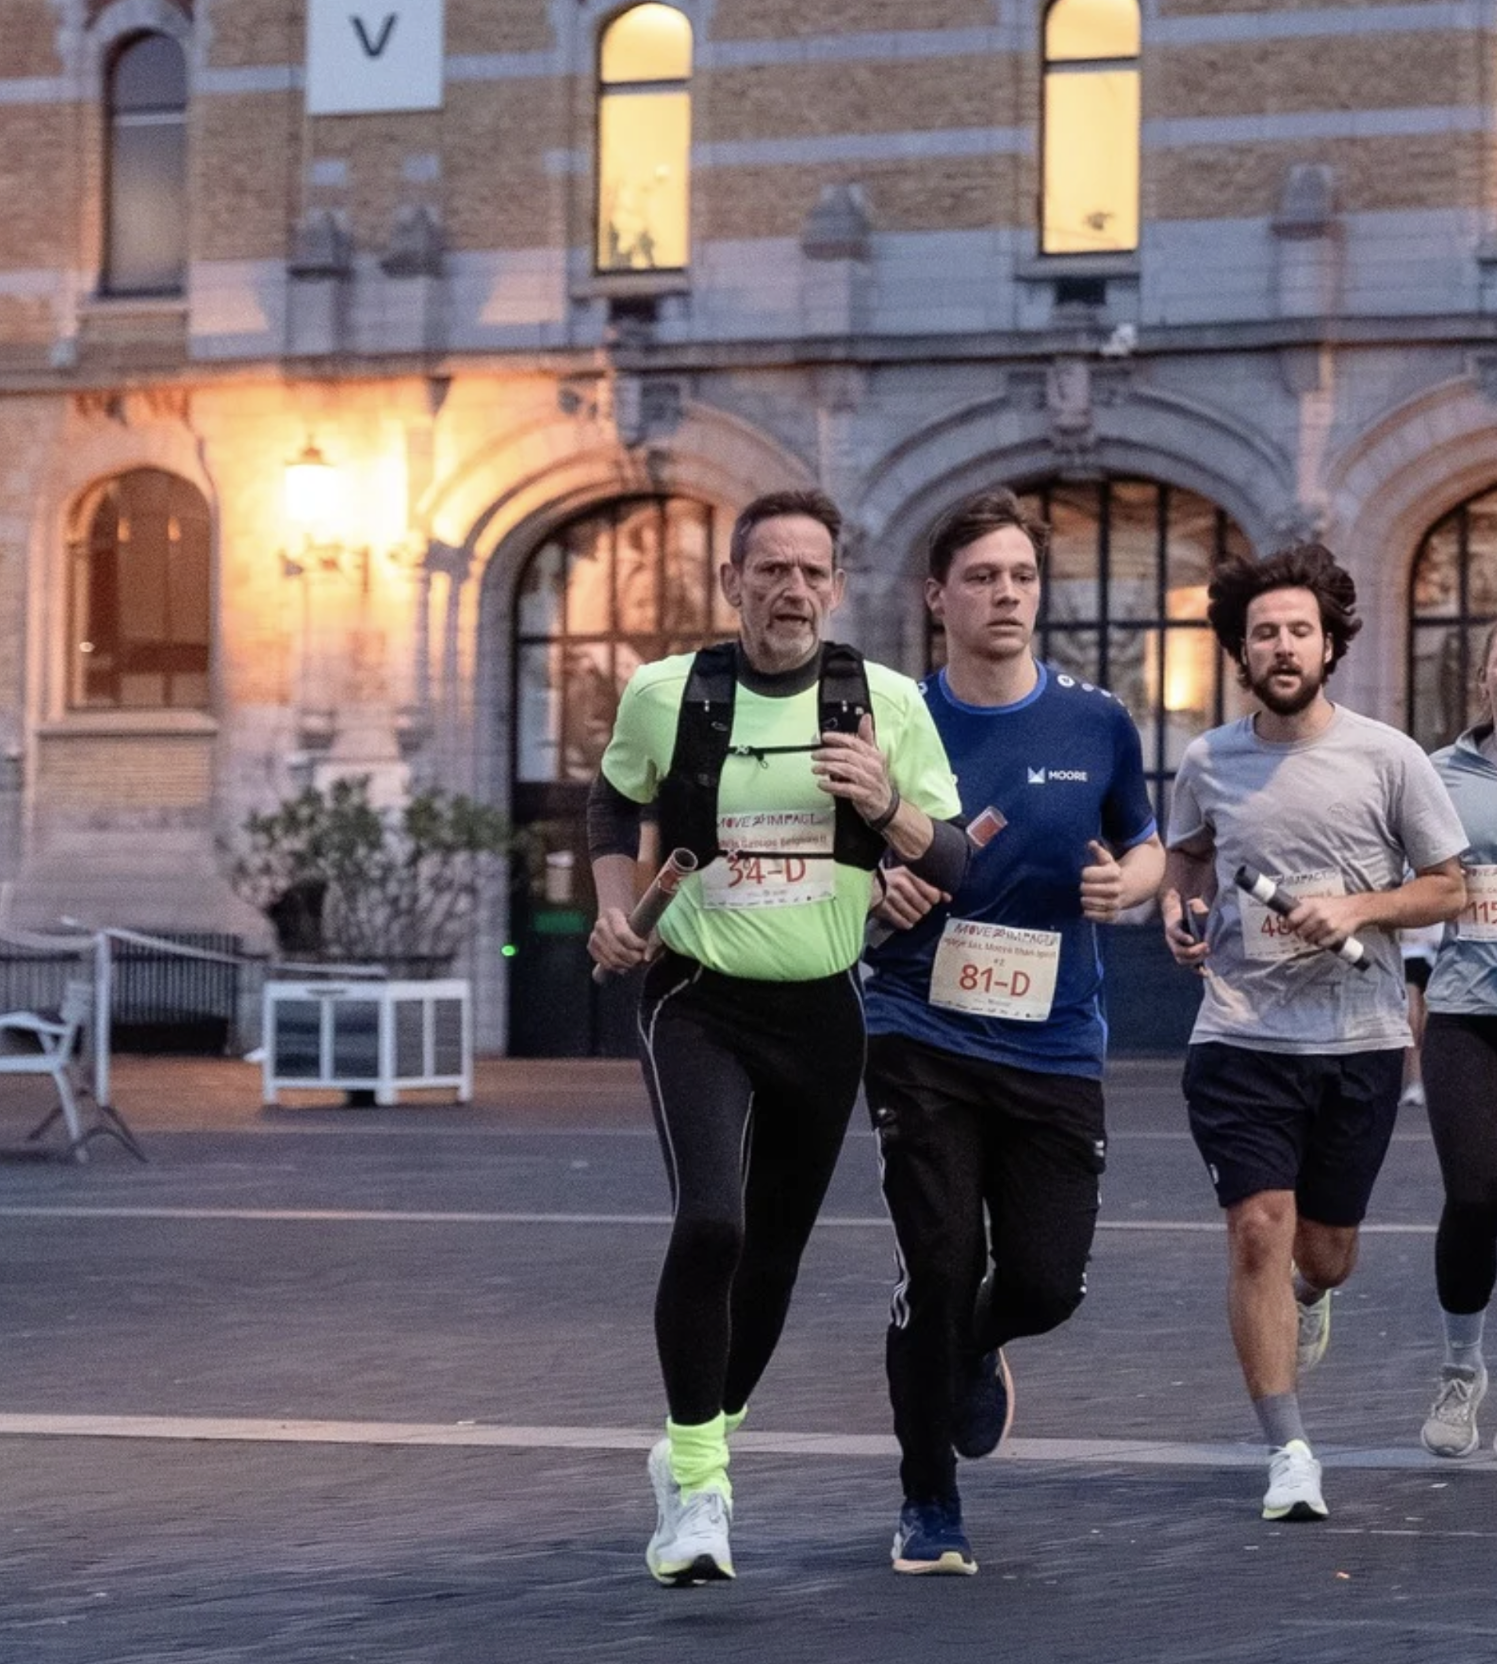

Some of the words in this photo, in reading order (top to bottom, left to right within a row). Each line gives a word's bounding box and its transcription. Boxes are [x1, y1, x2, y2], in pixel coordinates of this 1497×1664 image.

[349, 12, 398, 58] V
[1048, 769, 1088, 782] MOORE
[726, 856, 807, 888] 34-D
[953, 922, 993, 939] MOVE
[959, 963, 1031, 998] 81-D
